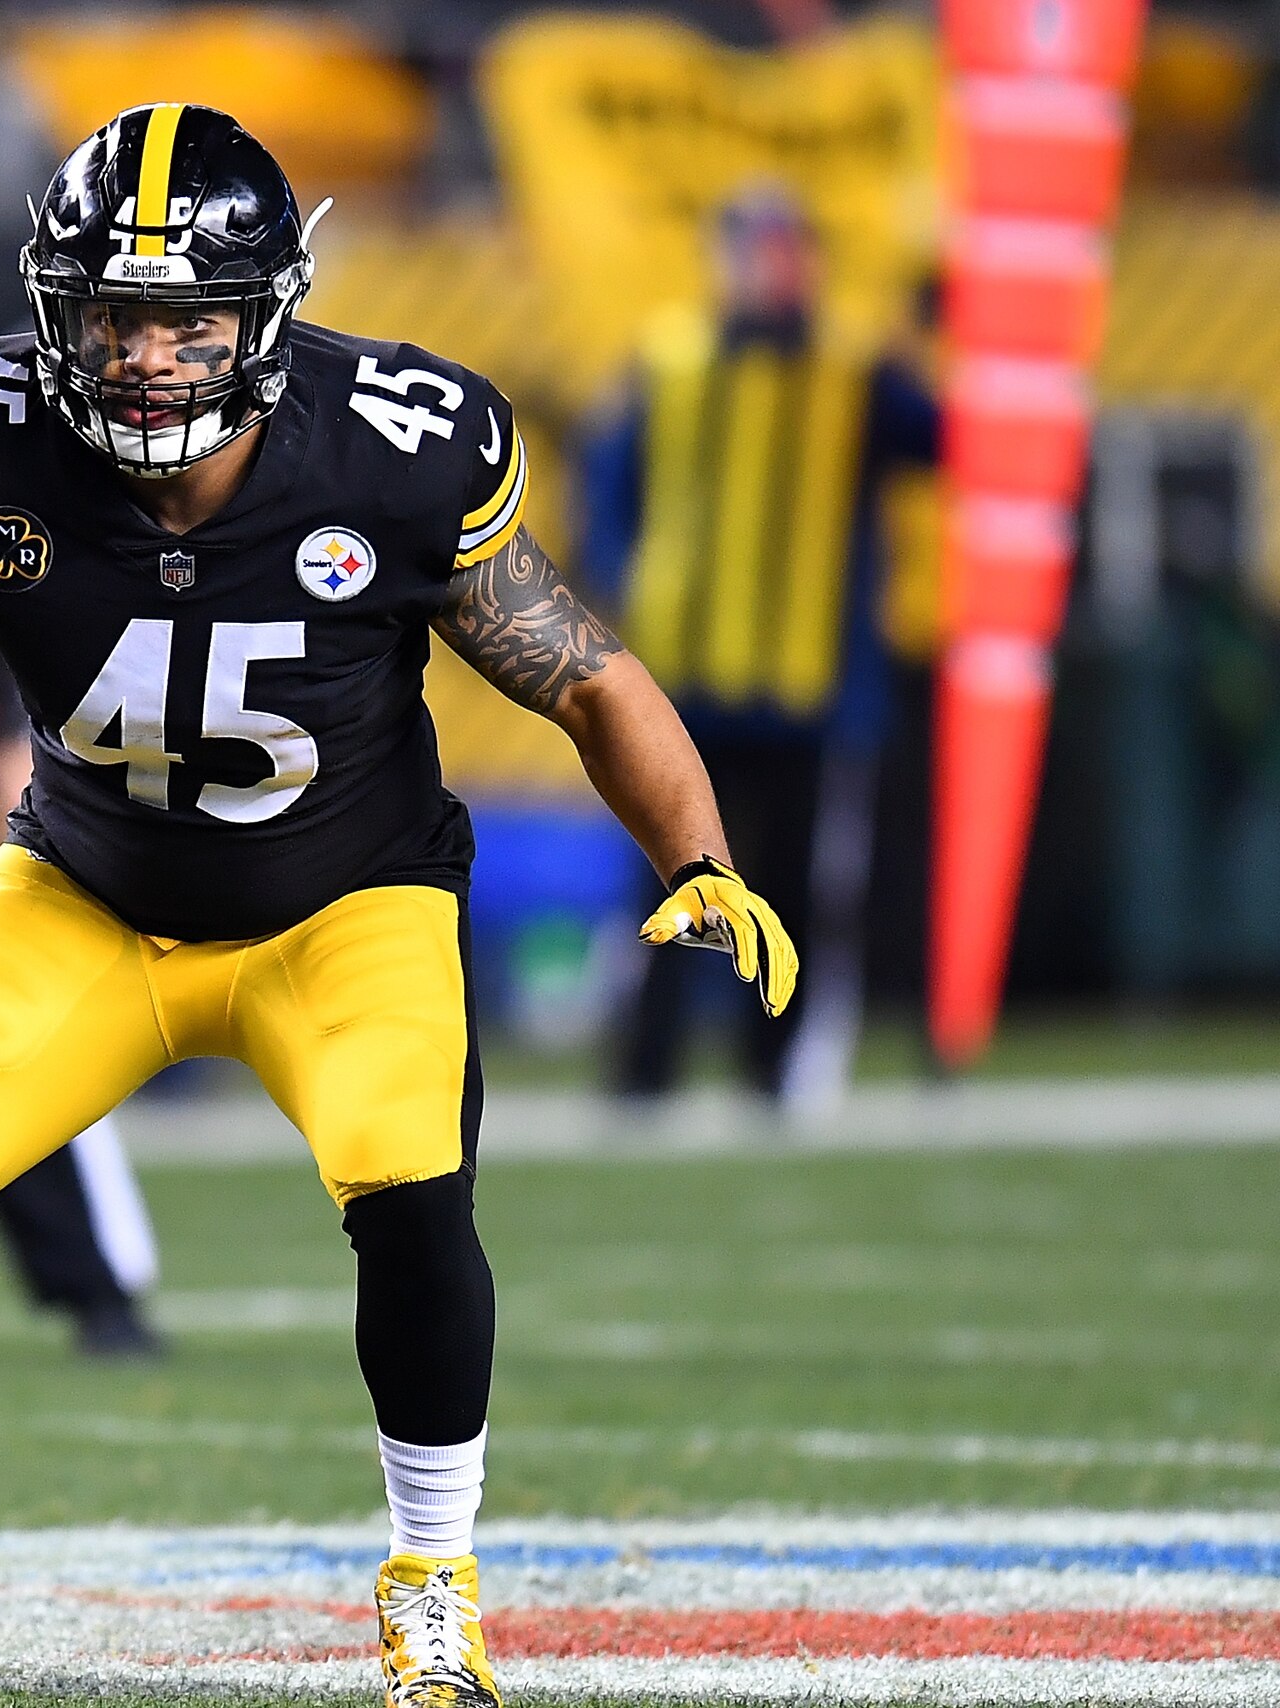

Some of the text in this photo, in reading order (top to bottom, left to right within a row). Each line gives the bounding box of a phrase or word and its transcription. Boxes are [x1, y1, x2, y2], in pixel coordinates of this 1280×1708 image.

[109, 196, 194, 254] 45
[122, 259, 170, 279] Steelers
[348, 354, 464, 455] 45
[165, 569, 190, 585] NFL
[302, 558, 333, 568] Steelers
[59, 618, 320, 824] 45
